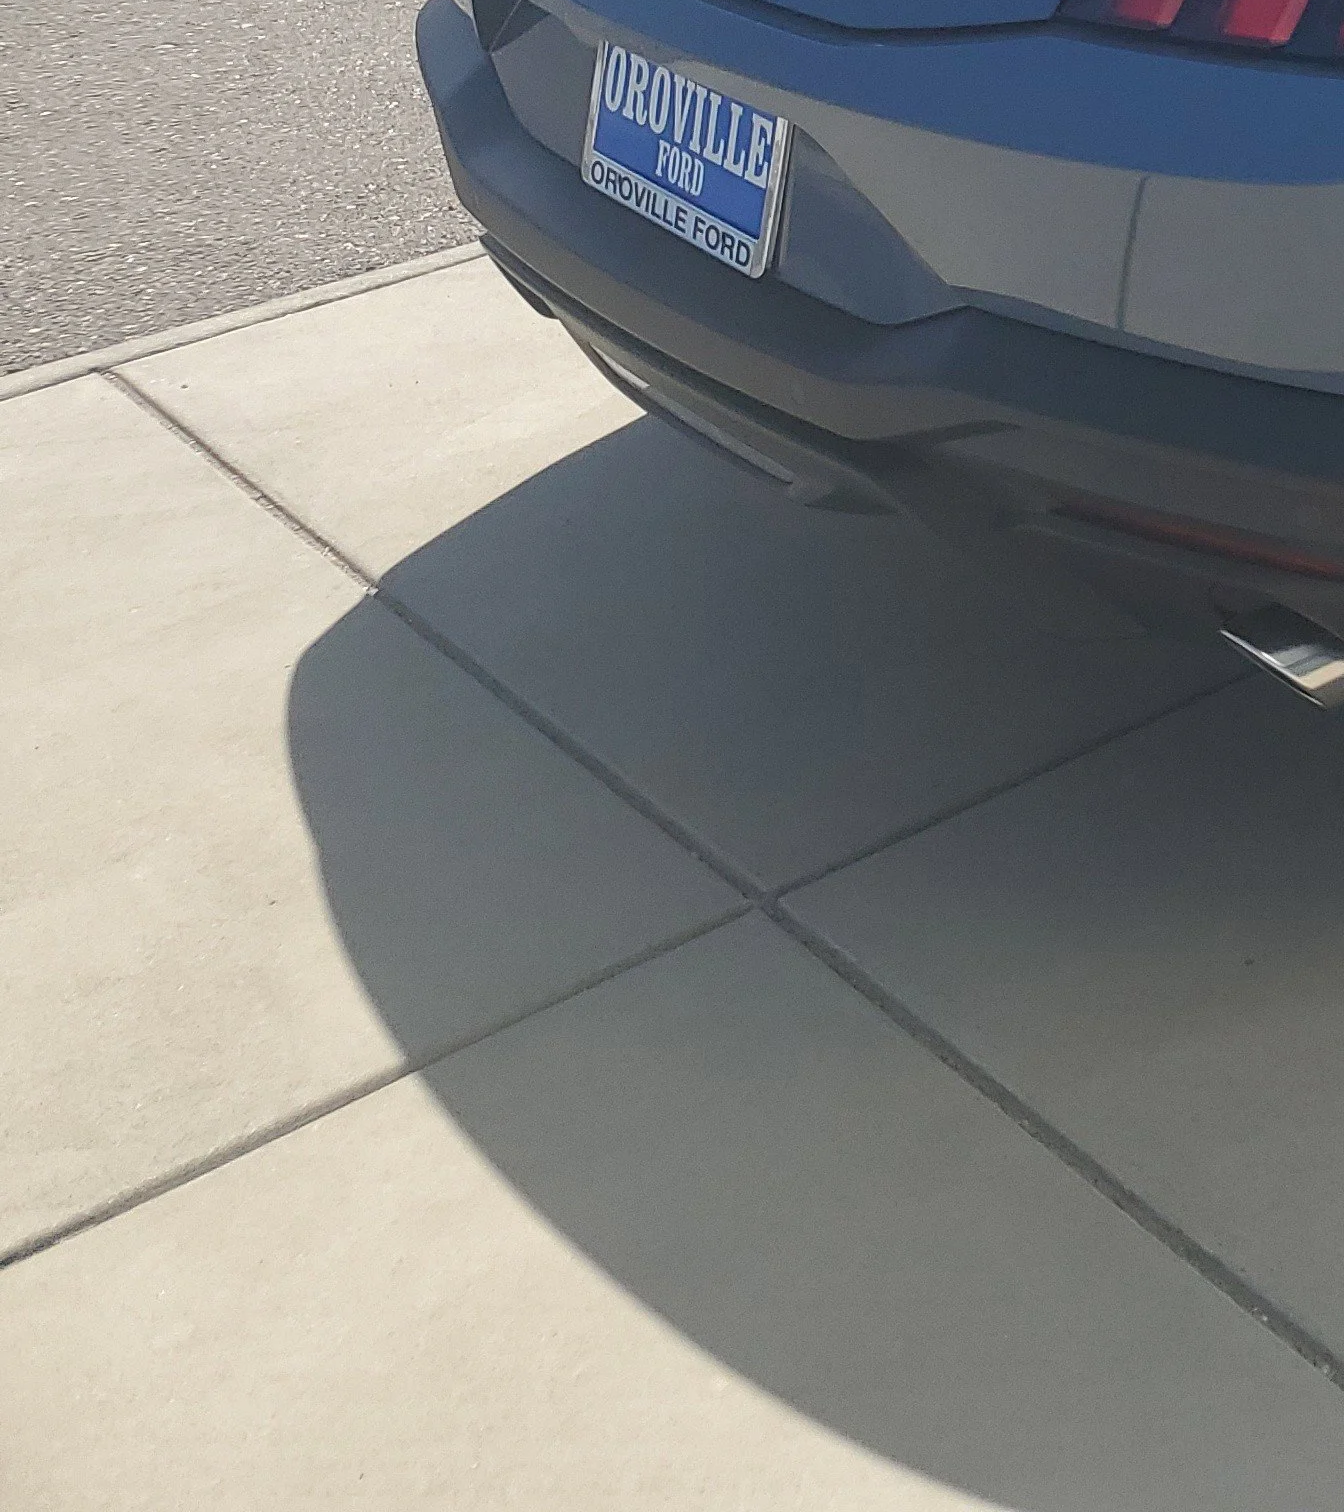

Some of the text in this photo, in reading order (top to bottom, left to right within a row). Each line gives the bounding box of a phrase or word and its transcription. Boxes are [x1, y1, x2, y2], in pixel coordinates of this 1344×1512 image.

[604, 45, 774, 189] OROVILLE
[655, 139, 705, 197] FORD
[590, 160, 752, 267] OROVILLE FORD
